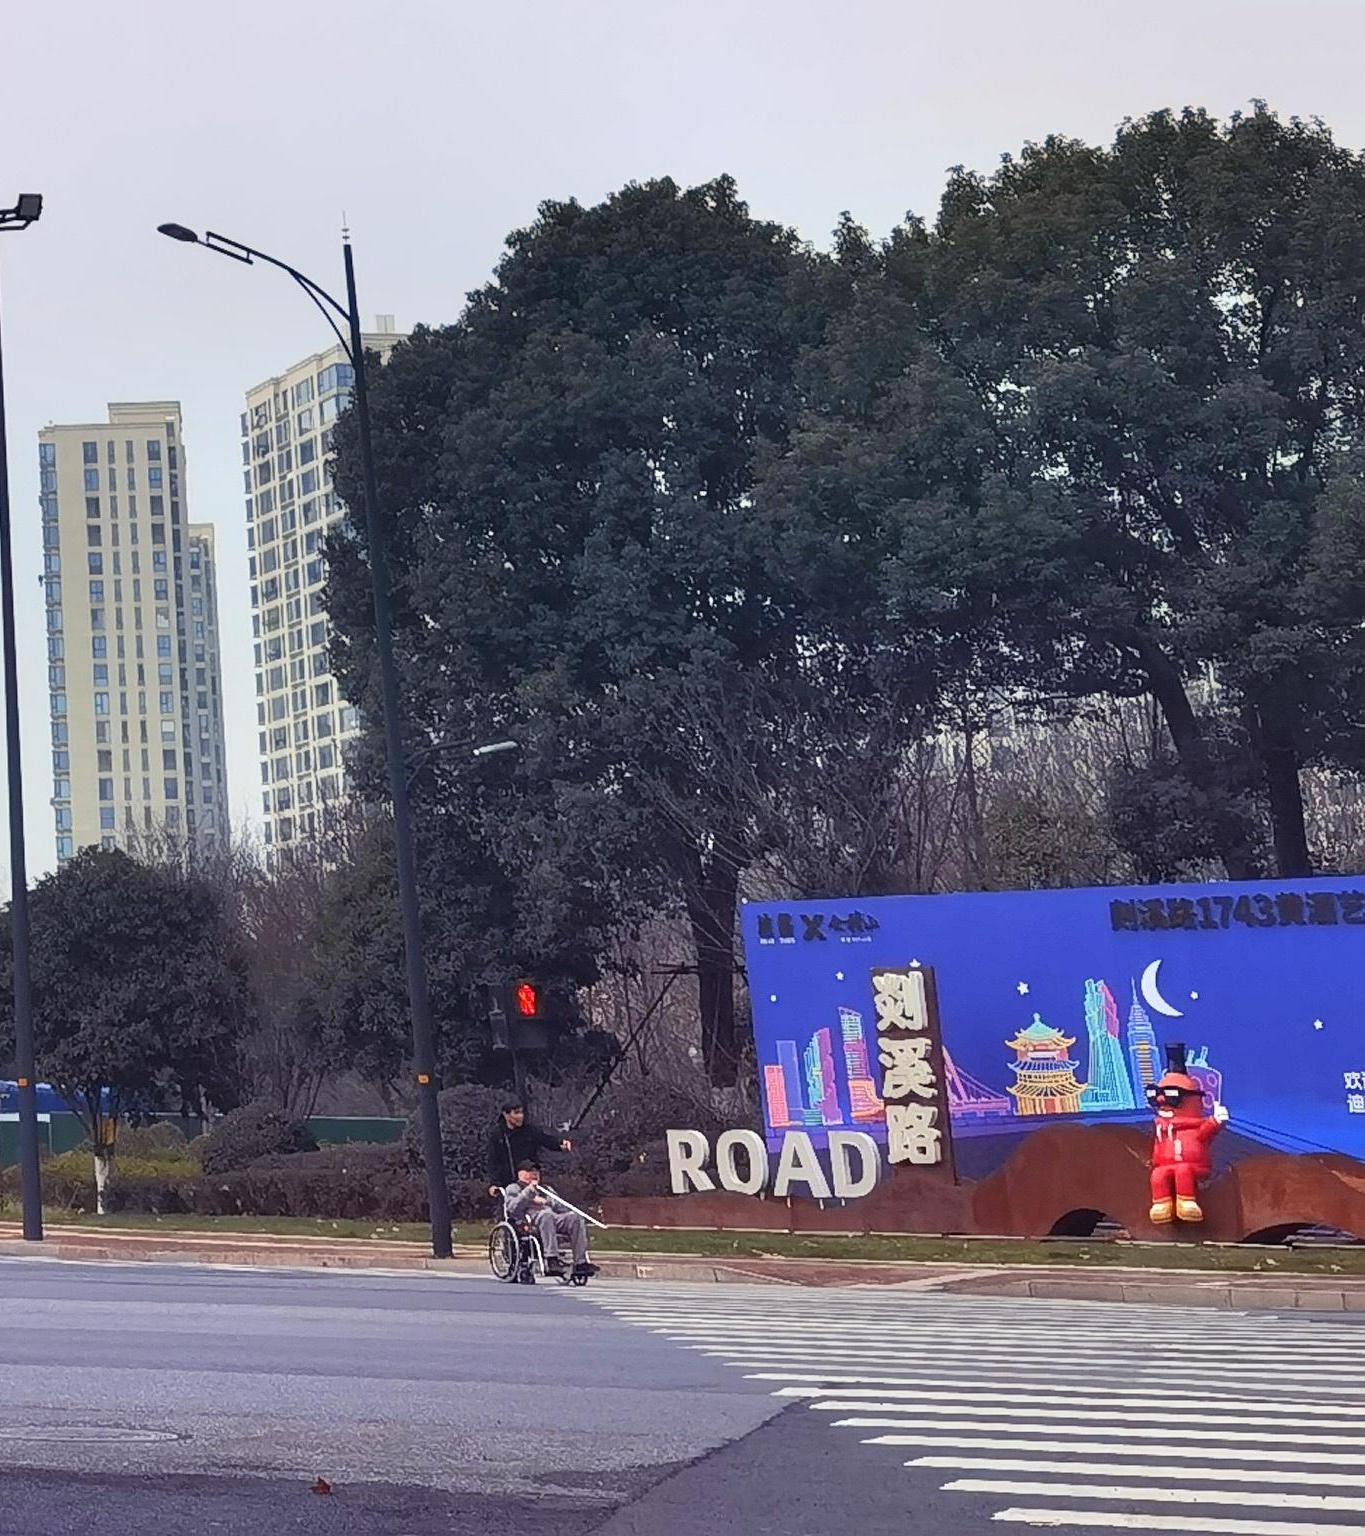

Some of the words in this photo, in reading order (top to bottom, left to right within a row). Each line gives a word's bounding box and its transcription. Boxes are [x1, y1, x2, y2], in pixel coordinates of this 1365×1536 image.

[872, 970, 942, 1164] 剡溪路
[666, 1129, 881, 1199] ROAD
